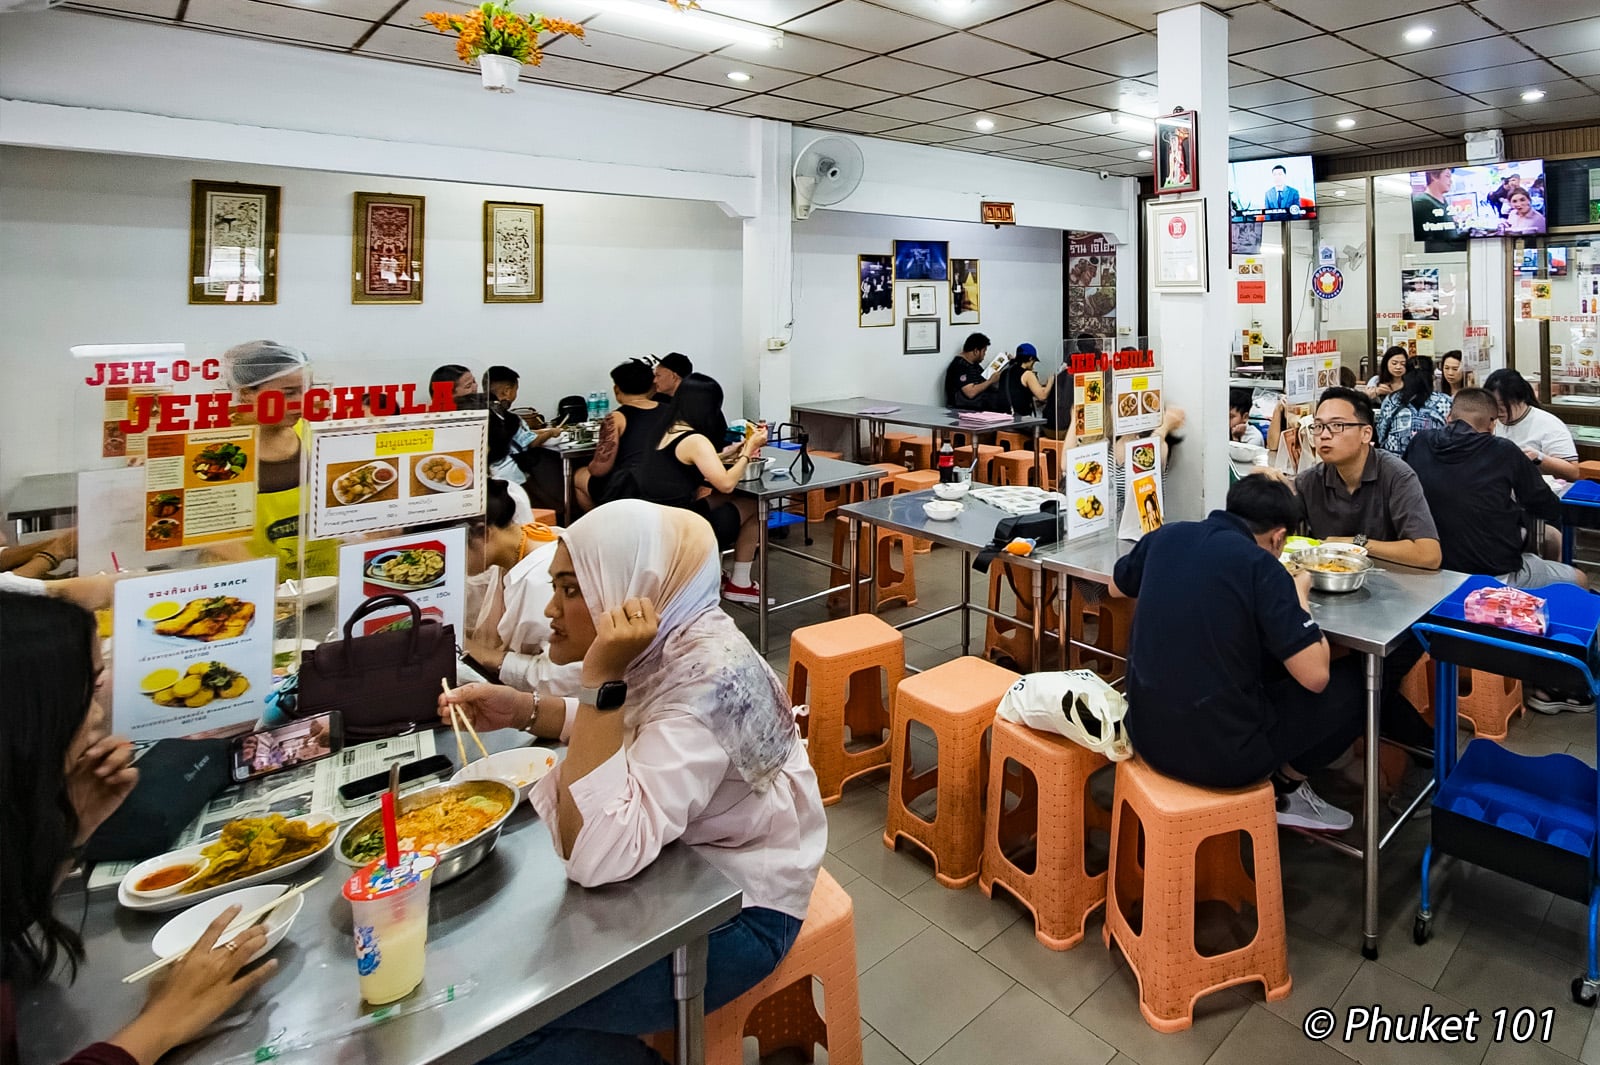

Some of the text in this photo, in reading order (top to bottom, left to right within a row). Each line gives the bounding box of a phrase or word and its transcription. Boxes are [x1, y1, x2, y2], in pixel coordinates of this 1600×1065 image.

[1067, 350, 1155, 375] JEH-O-CHULA
[118, 380, 458, 434] JEH-O-CHULA
[213, 578, 248, 589] SNACK
